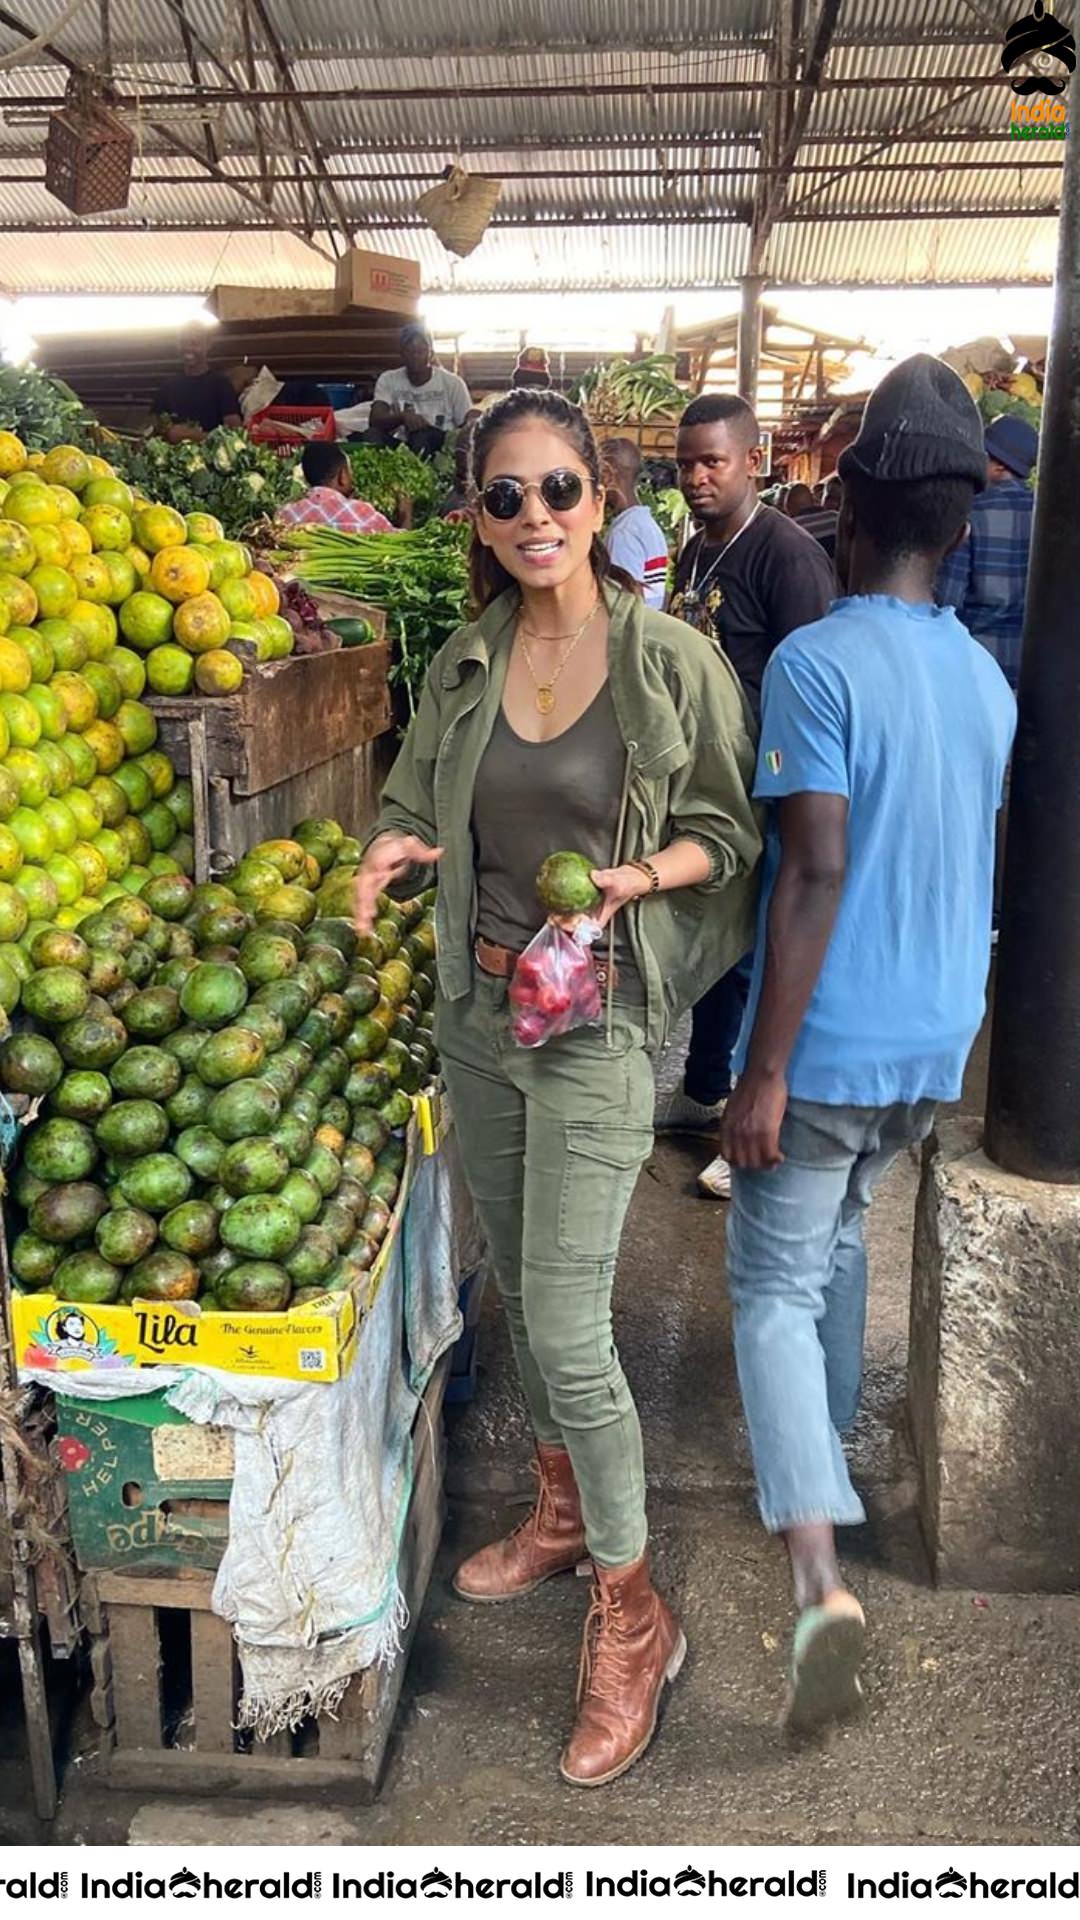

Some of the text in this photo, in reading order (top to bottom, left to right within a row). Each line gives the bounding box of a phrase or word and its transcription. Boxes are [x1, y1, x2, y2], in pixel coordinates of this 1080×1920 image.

[135, 1312, 198, 1354] Lila
[222, 1322, 240, 1335] The
[244, 1324, 283, 1336] Genuine
[76, 1411, 119, 1498] HELPER
